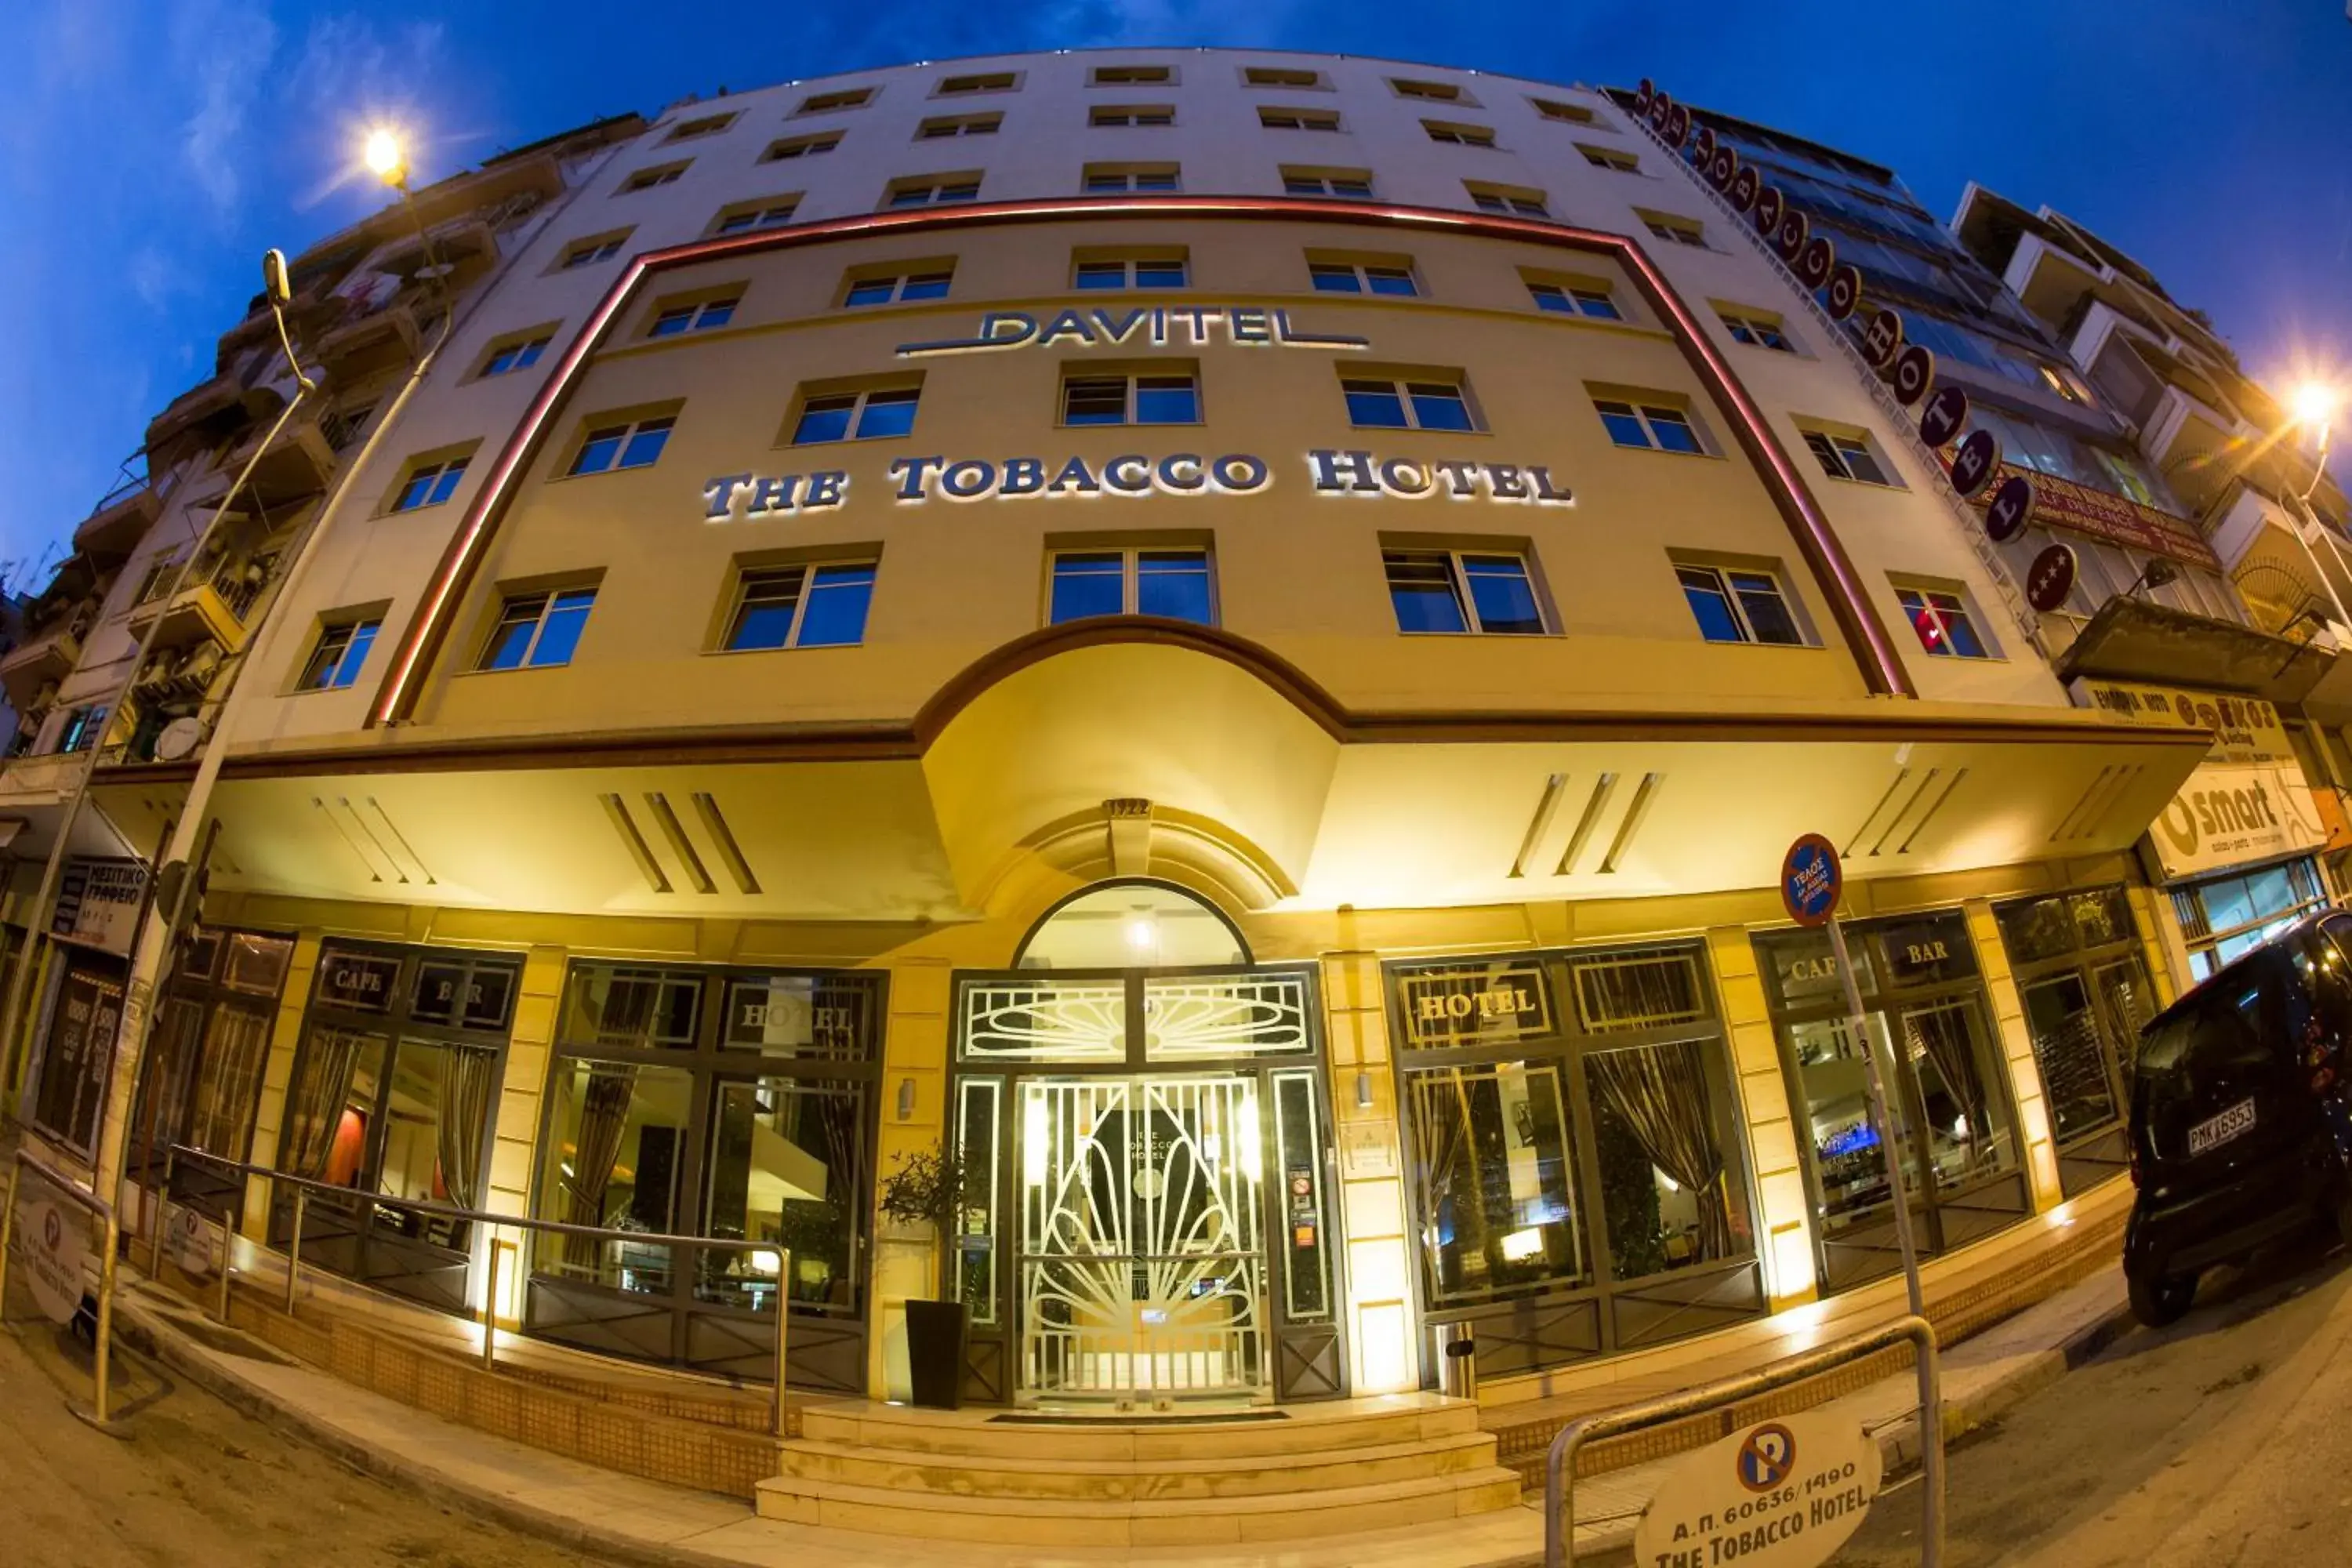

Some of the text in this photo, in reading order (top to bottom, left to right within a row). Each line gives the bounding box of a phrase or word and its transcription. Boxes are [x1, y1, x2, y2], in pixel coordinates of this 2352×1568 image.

[895, 307, 1369, 355] DAVITEL
[704, 449, 1574, 521] THE TOBACCO HOTEL
[2193, 779, 2278, 836] smart
[1791, 940, 1950, 981] CAF BAR
[336, 969, 483, 1004] CAFE BR
[1417, 989, 1536, 1019] HOTEL
[2220, 1102, 2252, 1134] 6953
[1709, 1511, 1805, 1566] TOBACCO
